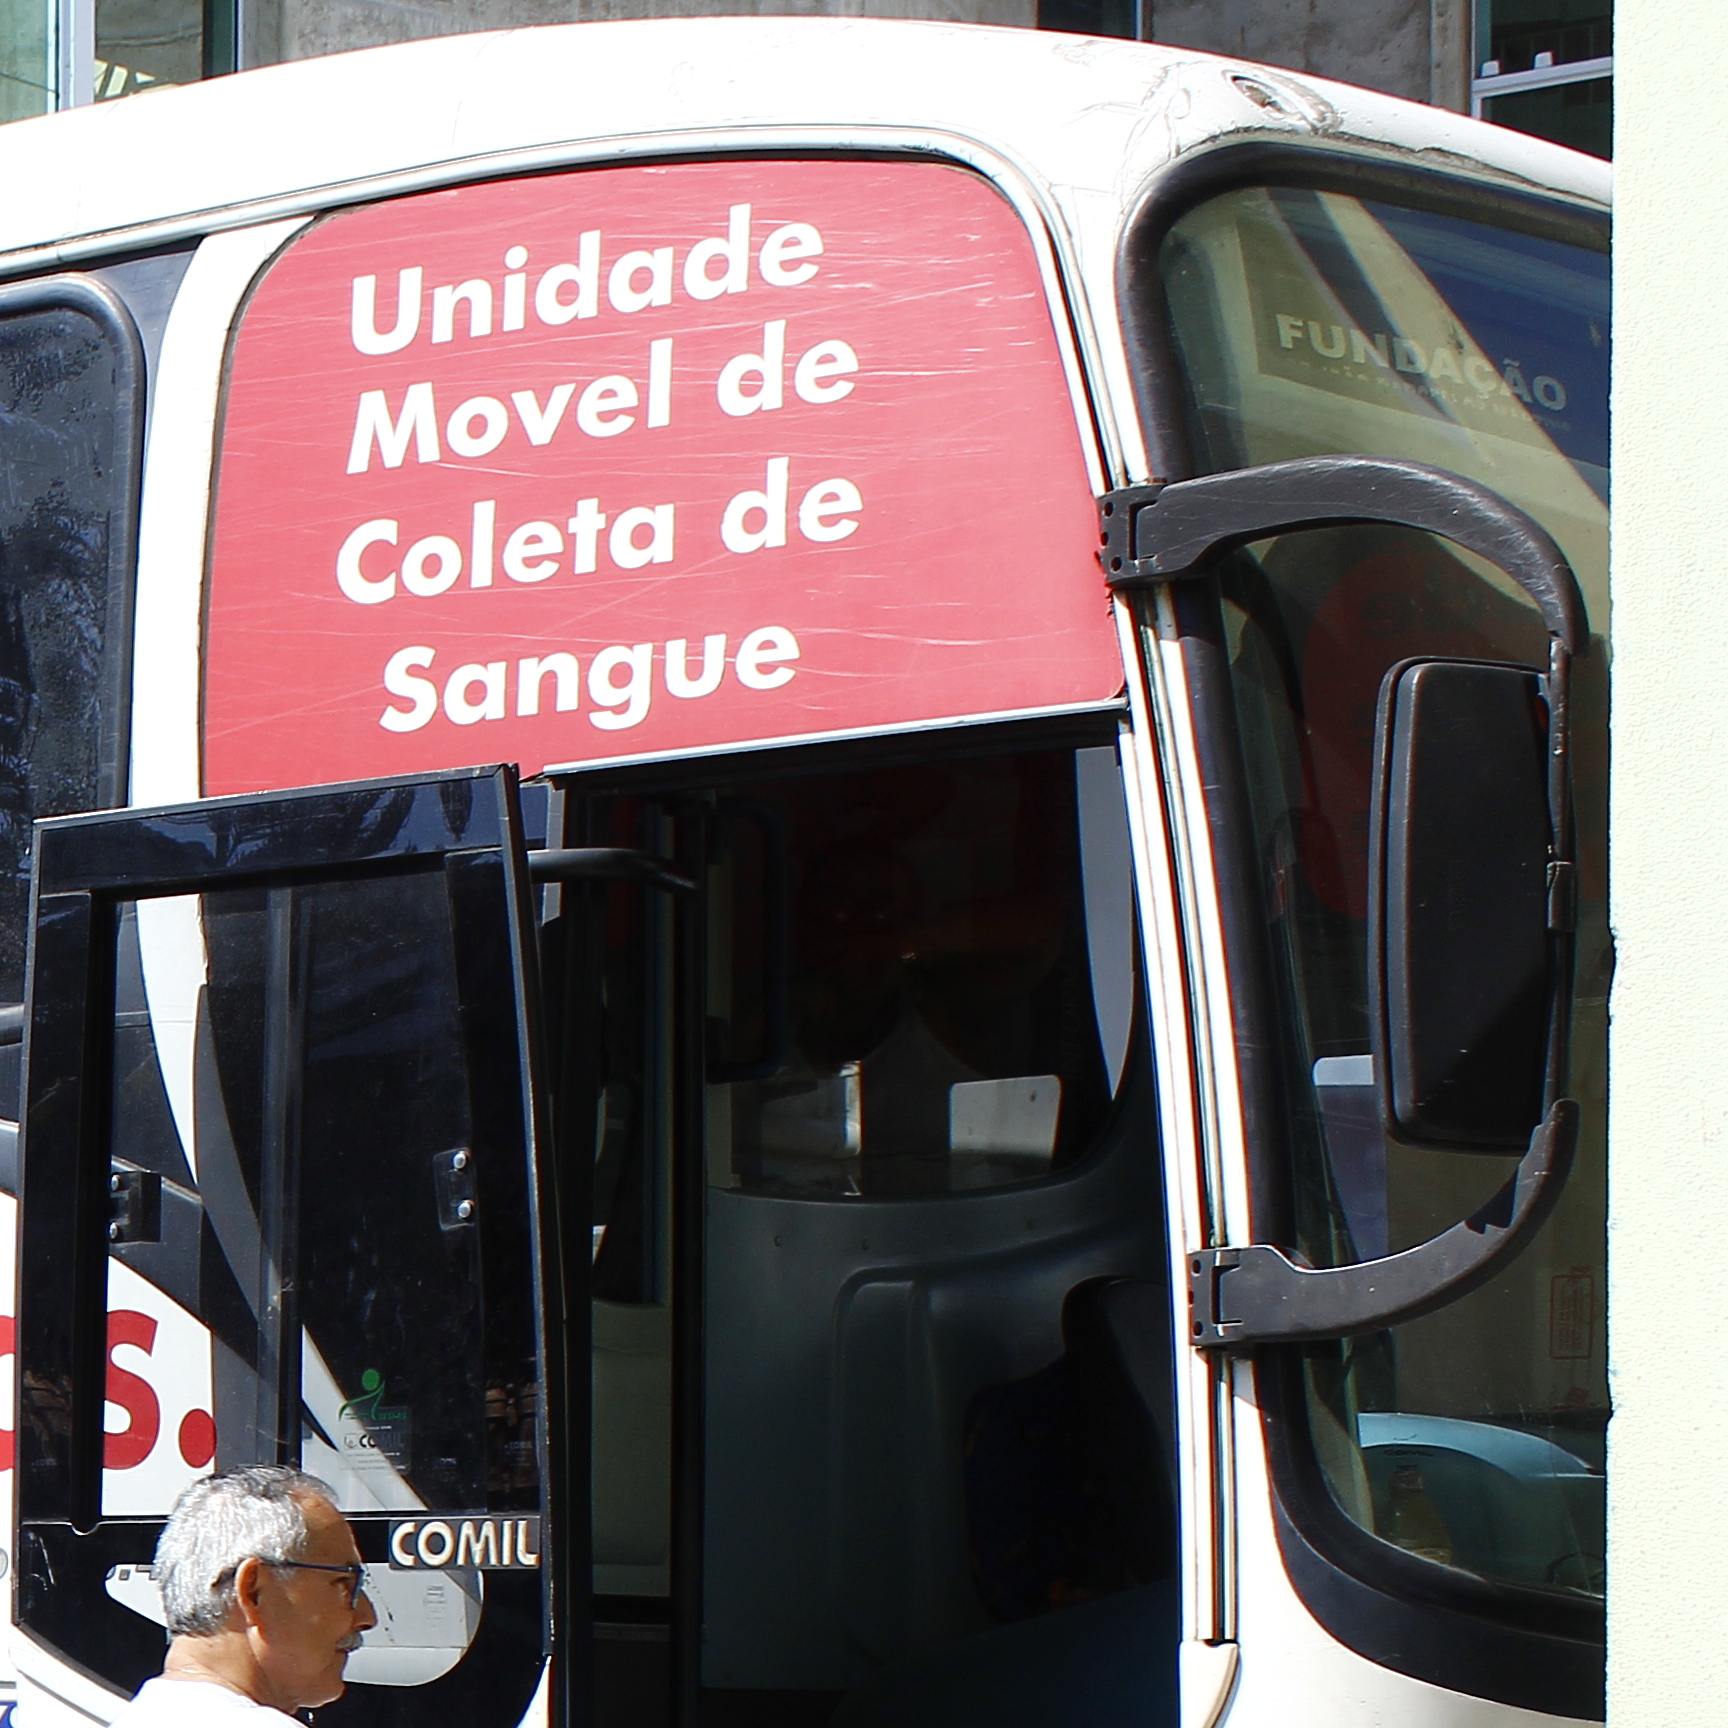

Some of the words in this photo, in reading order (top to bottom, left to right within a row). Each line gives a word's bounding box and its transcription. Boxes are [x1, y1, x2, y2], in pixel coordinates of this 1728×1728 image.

[349, 203, 824, 356] Unidade
[345, 337, 674, 476] Movel
[716, 319, 860, 417] de
[1276, 313, 1567, 411] FUNDAÇÃO
[335, 498, 676, 605] Coleta
[720, 455, 864, 554] de
[378, 625, 801, 733] Sangue
[391, 1519, 538, 1567] COMIL
